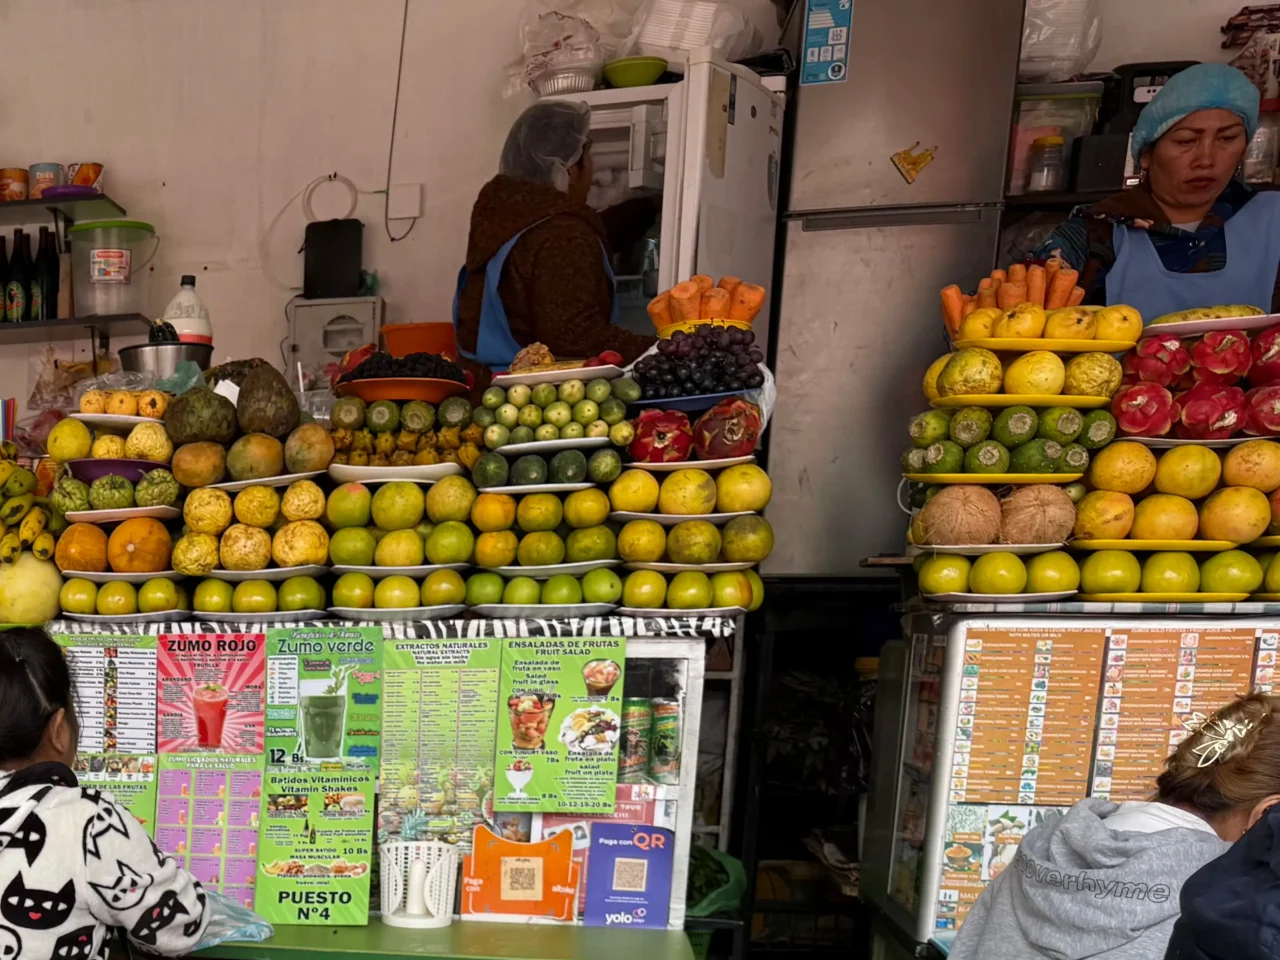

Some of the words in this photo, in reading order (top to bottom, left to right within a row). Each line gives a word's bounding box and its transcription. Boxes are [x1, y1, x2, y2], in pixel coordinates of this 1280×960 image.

[167, 640, 212, 652] ZUMO
[216, 640, 257, 652] ROJO
[278, 639, 323, 654] Zumo
[328, 639, 374, 654] verde
[583, 640, 619, 648] FRUTAS
[270, 749, 286, 763] 12
[599, 838, 618, 846] Paga
[633, 832, 666, 850] QR
[464, 877, 483, 886] Paga
[278, 892, 352, 904] PUESTO
[605, 911, 632, 925] yolo
